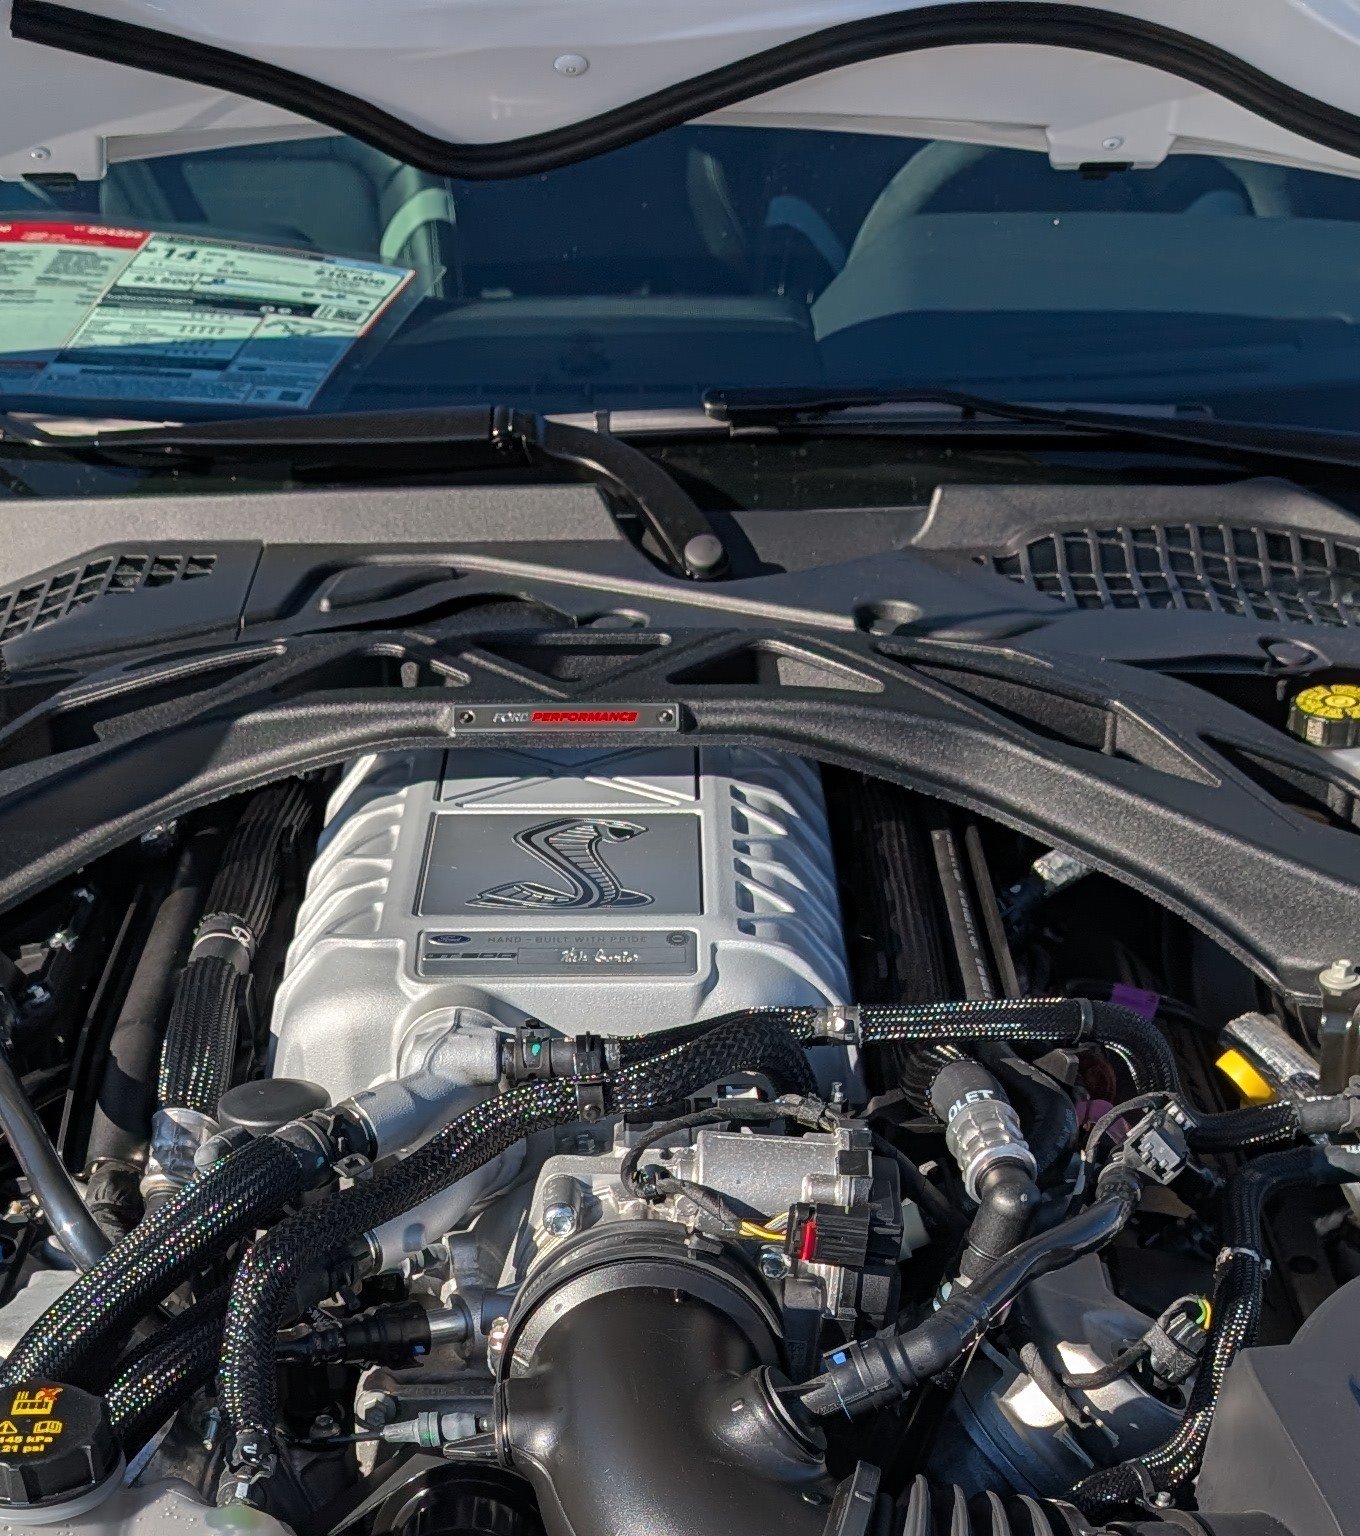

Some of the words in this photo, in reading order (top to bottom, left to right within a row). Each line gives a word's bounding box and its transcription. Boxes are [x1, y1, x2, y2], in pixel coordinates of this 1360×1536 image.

[493, 711, 529, 723] FORD
[532, 711, 638, 722] PERFORMANCE
[488, 935, 522, 944] HAND
[535, 935, 569, 944] BUILT
[574, 935, 605, 943] WITH
[609, 935, 648, 943] PRIDE
[26, 1435, 54, 1443] kPa
[1, 1444, 19, 1453] 21
[22, 1444, 45, 1454] psi
